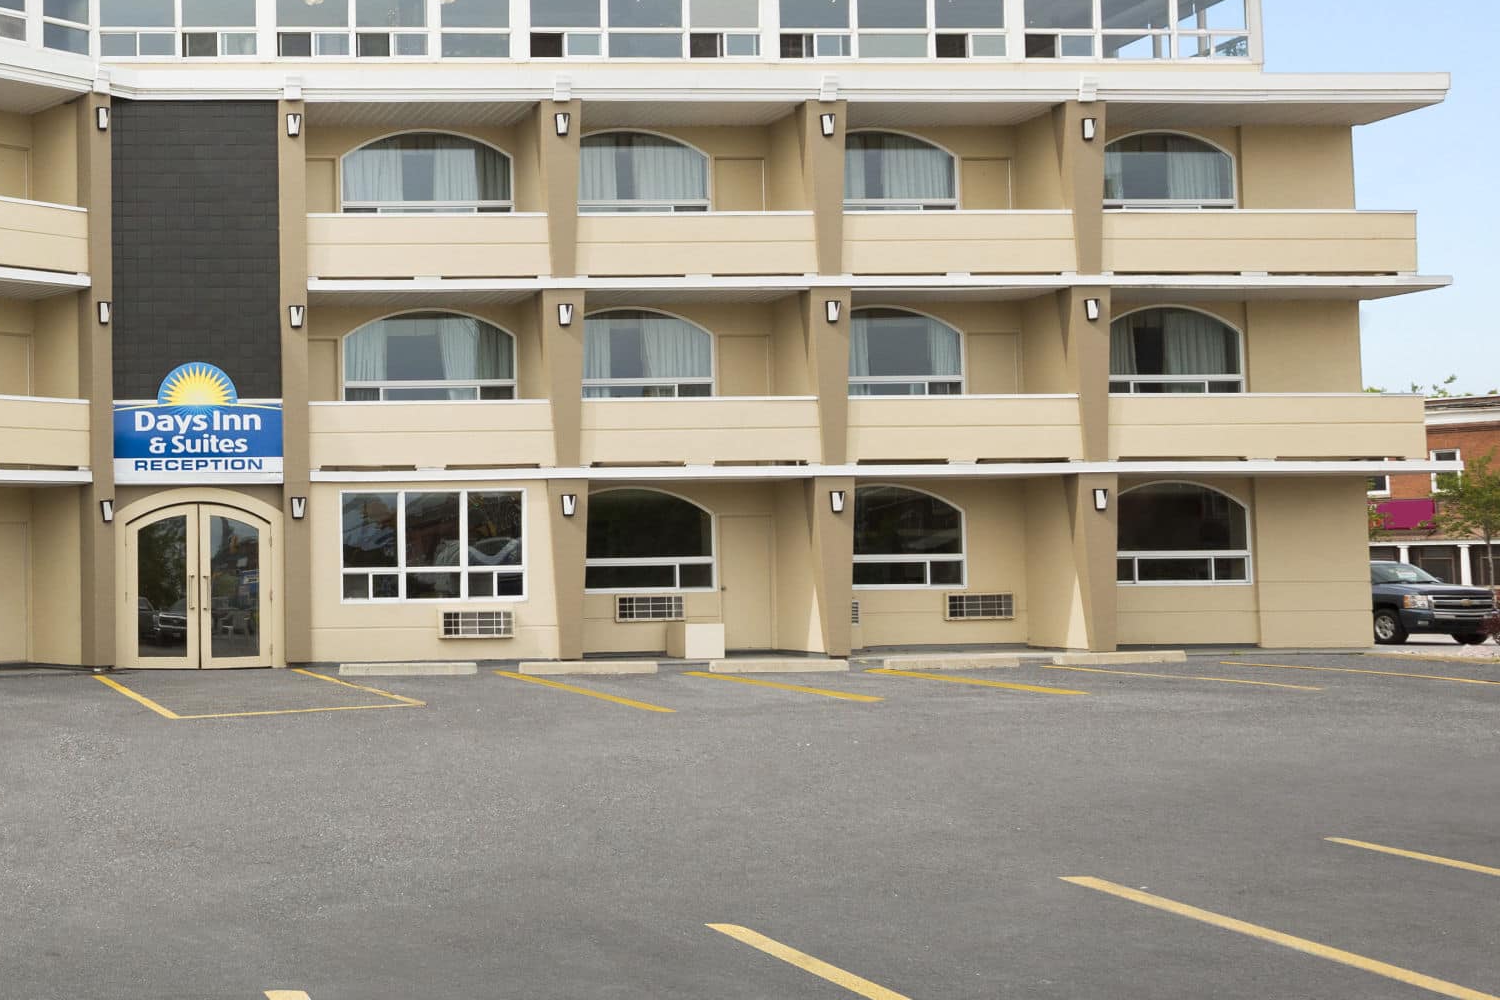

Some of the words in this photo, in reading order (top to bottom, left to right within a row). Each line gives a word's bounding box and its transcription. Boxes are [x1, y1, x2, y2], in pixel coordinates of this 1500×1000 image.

[134, 410, 208, 434] Days
[213, 410, 262, 431] Inn
[149, 436, 167, 454] &
[171, 433, 248, 454] Suites
[134, 459, 263, 471] RECEPTION
